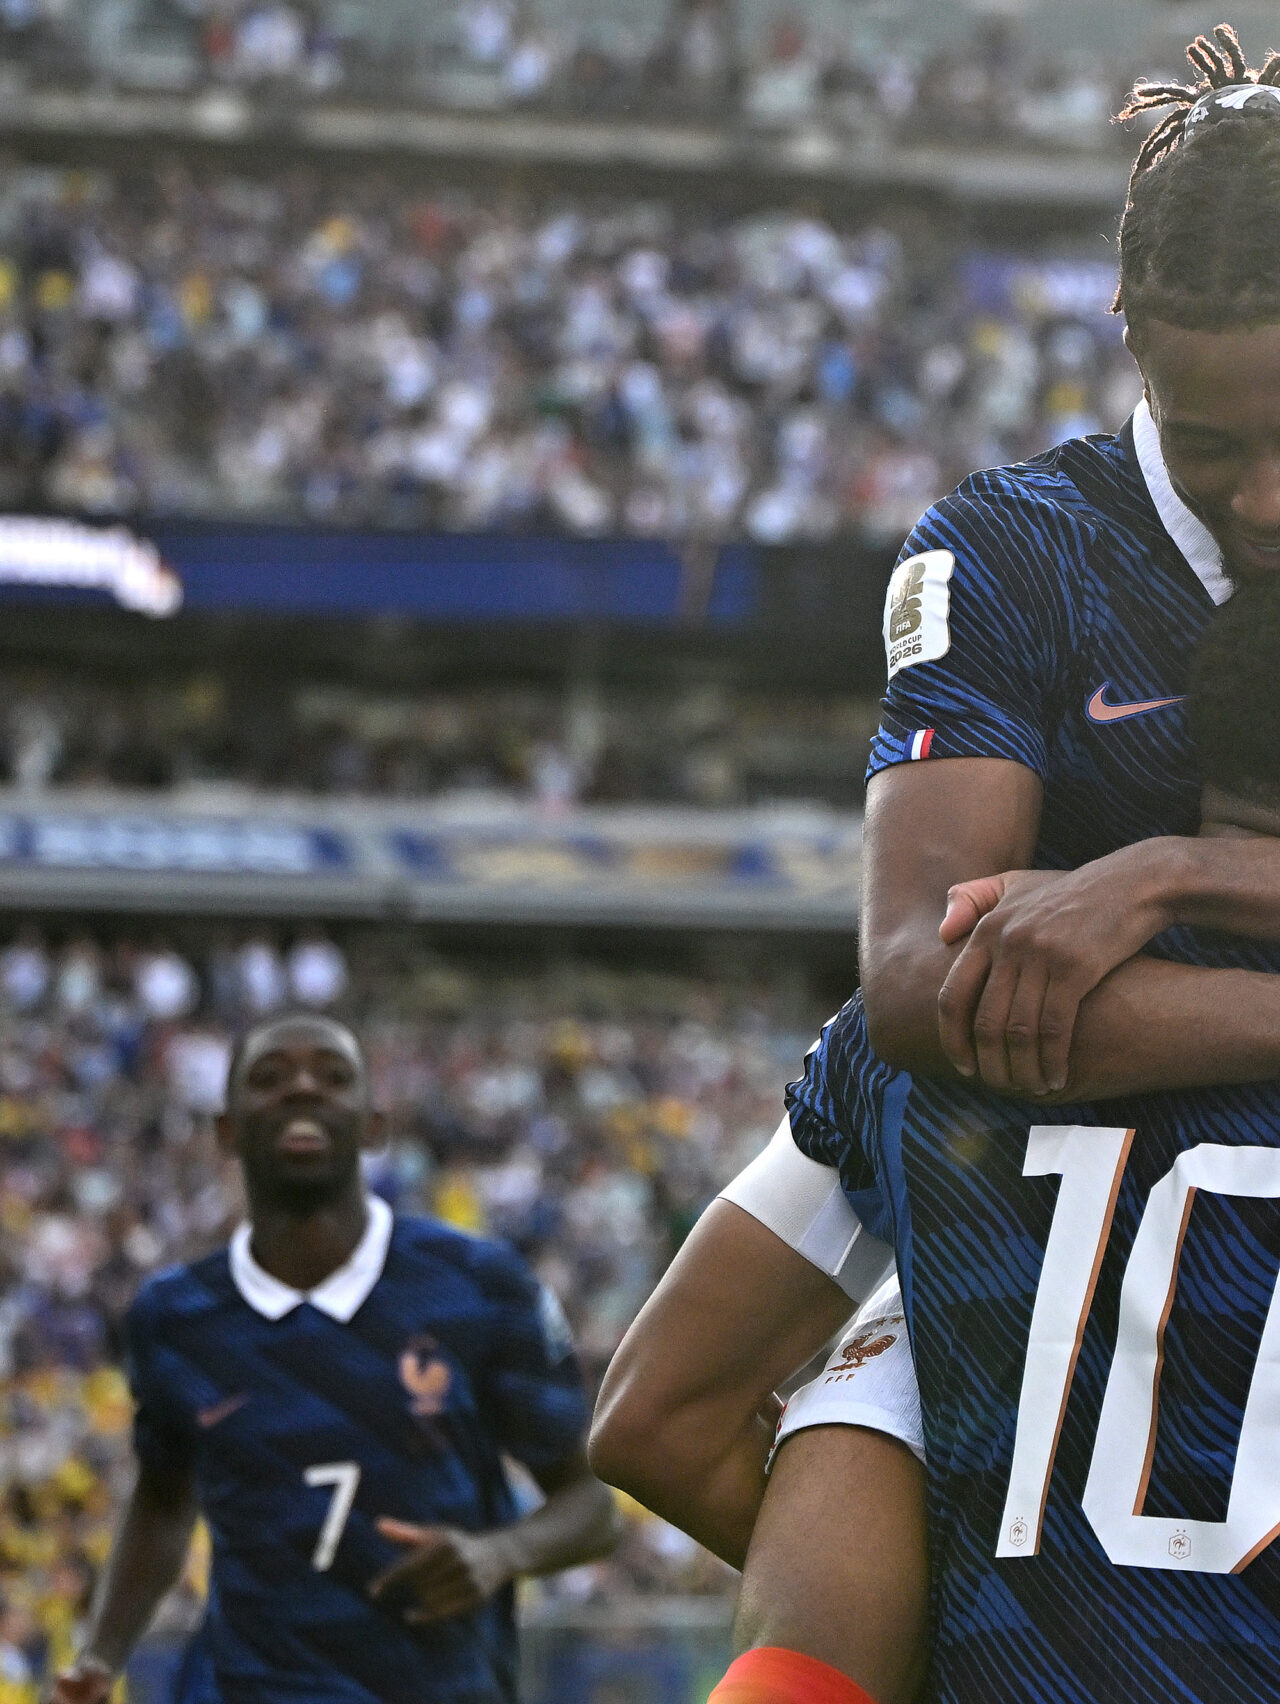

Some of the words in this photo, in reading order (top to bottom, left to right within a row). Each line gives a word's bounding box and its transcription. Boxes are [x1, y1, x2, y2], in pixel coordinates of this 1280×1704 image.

[896, 621, 911, 634] FIFA
[889, 643, 922, 668] 2026
[890, 640, 907, 655] WORLD
[908, 635, 922, 644] CUP
[304, 1461, 360, 1573] 7
